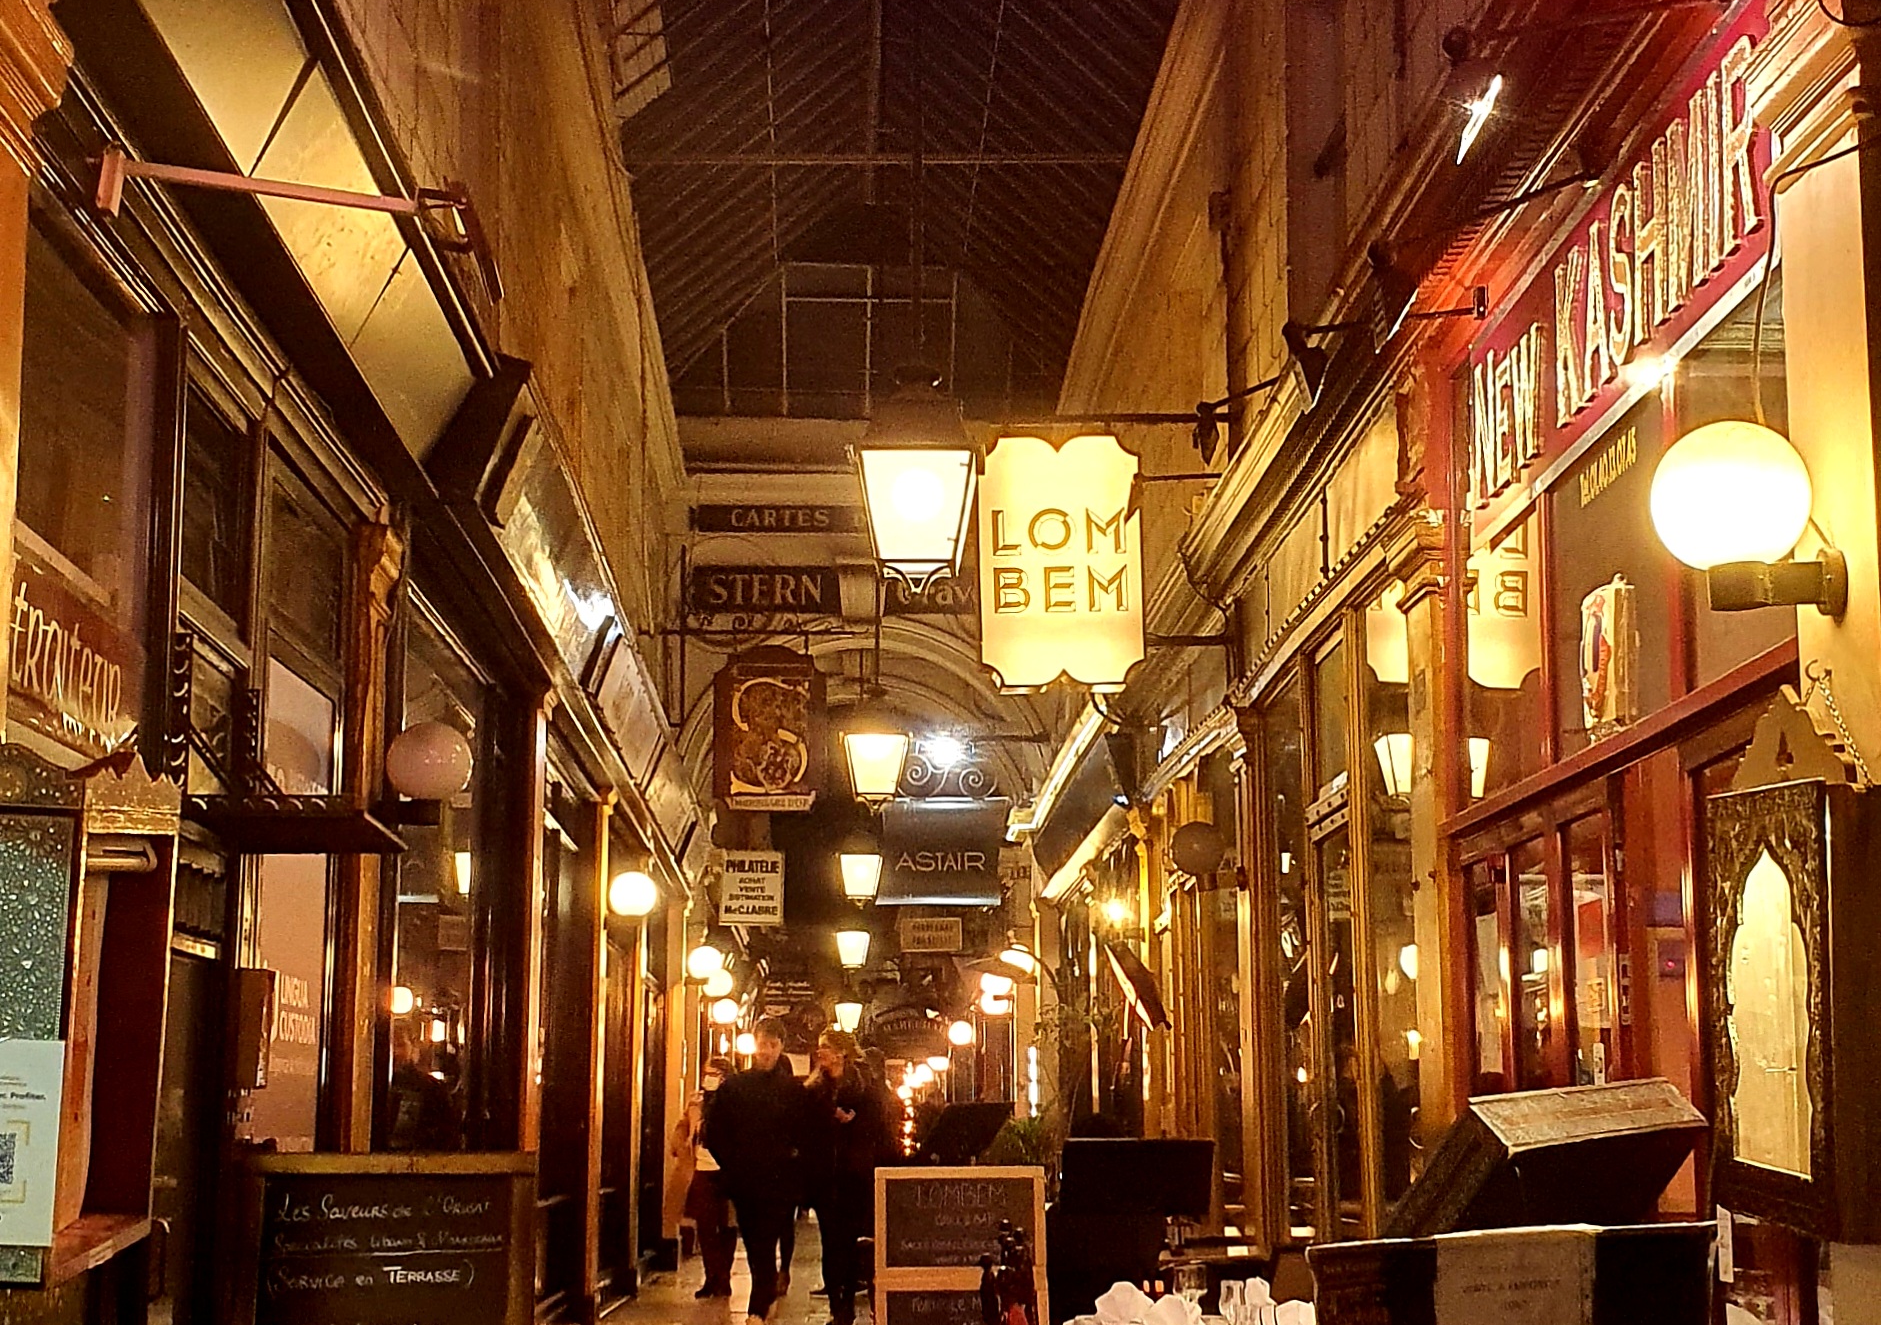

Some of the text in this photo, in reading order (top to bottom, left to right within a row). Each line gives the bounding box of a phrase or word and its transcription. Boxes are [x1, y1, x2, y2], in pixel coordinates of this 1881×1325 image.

[1472, 321, 1545, 507] NEW
[1554, 35, 1762, 427] KASHMIR
[730, 509, 831, 527] CARTES
[991, 507, 1127, 556] LOM
[709, 574, 823, 606] STERN
[993, 564, 1129, 614] BEM
[726, 859, 779, 874] PHILATELIE
[895, 851, 986, 872] ASTAIR
